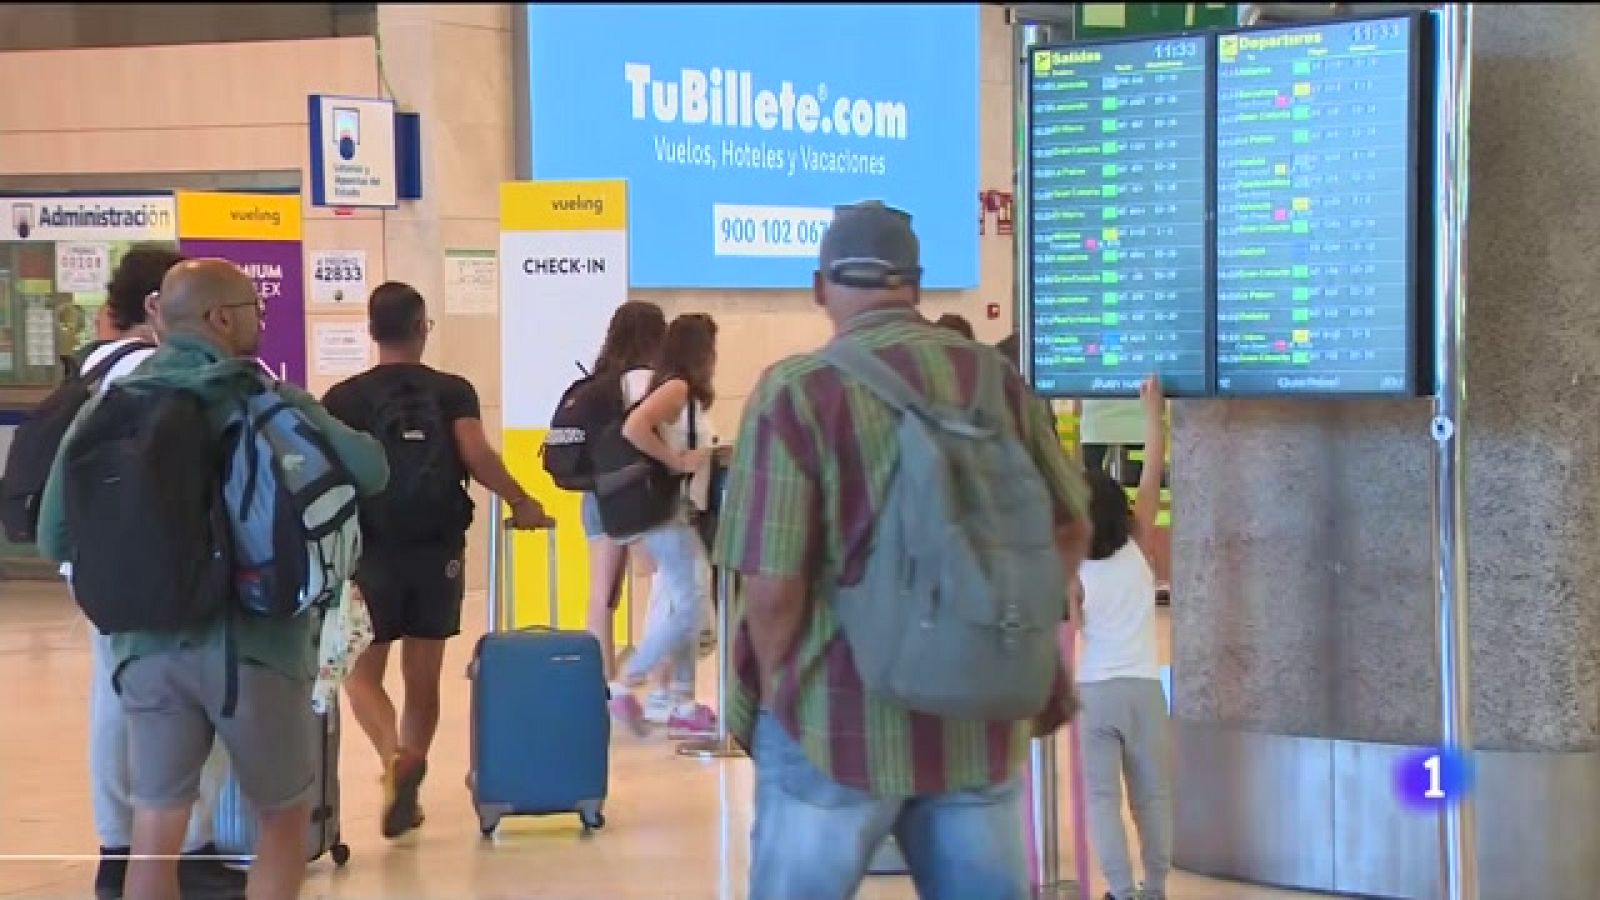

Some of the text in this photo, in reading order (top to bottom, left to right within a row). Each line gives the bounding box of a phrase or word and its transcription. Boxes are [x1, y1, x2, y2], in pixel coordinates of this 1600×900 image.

[1154, 42, 1196, 58] 11:33
[653, 135, 887, 177] Vuelos, Hoteles y Vacaciones
[39, 204, 171, 227] Administración
[552, 194, 604, 216] vueling
[229, 206, 281, 227] vueling
[721, 217, 756, 243] 900
[762, 219, 792, 244] 102
[523, 257, 606, 275] CHECK-IN
